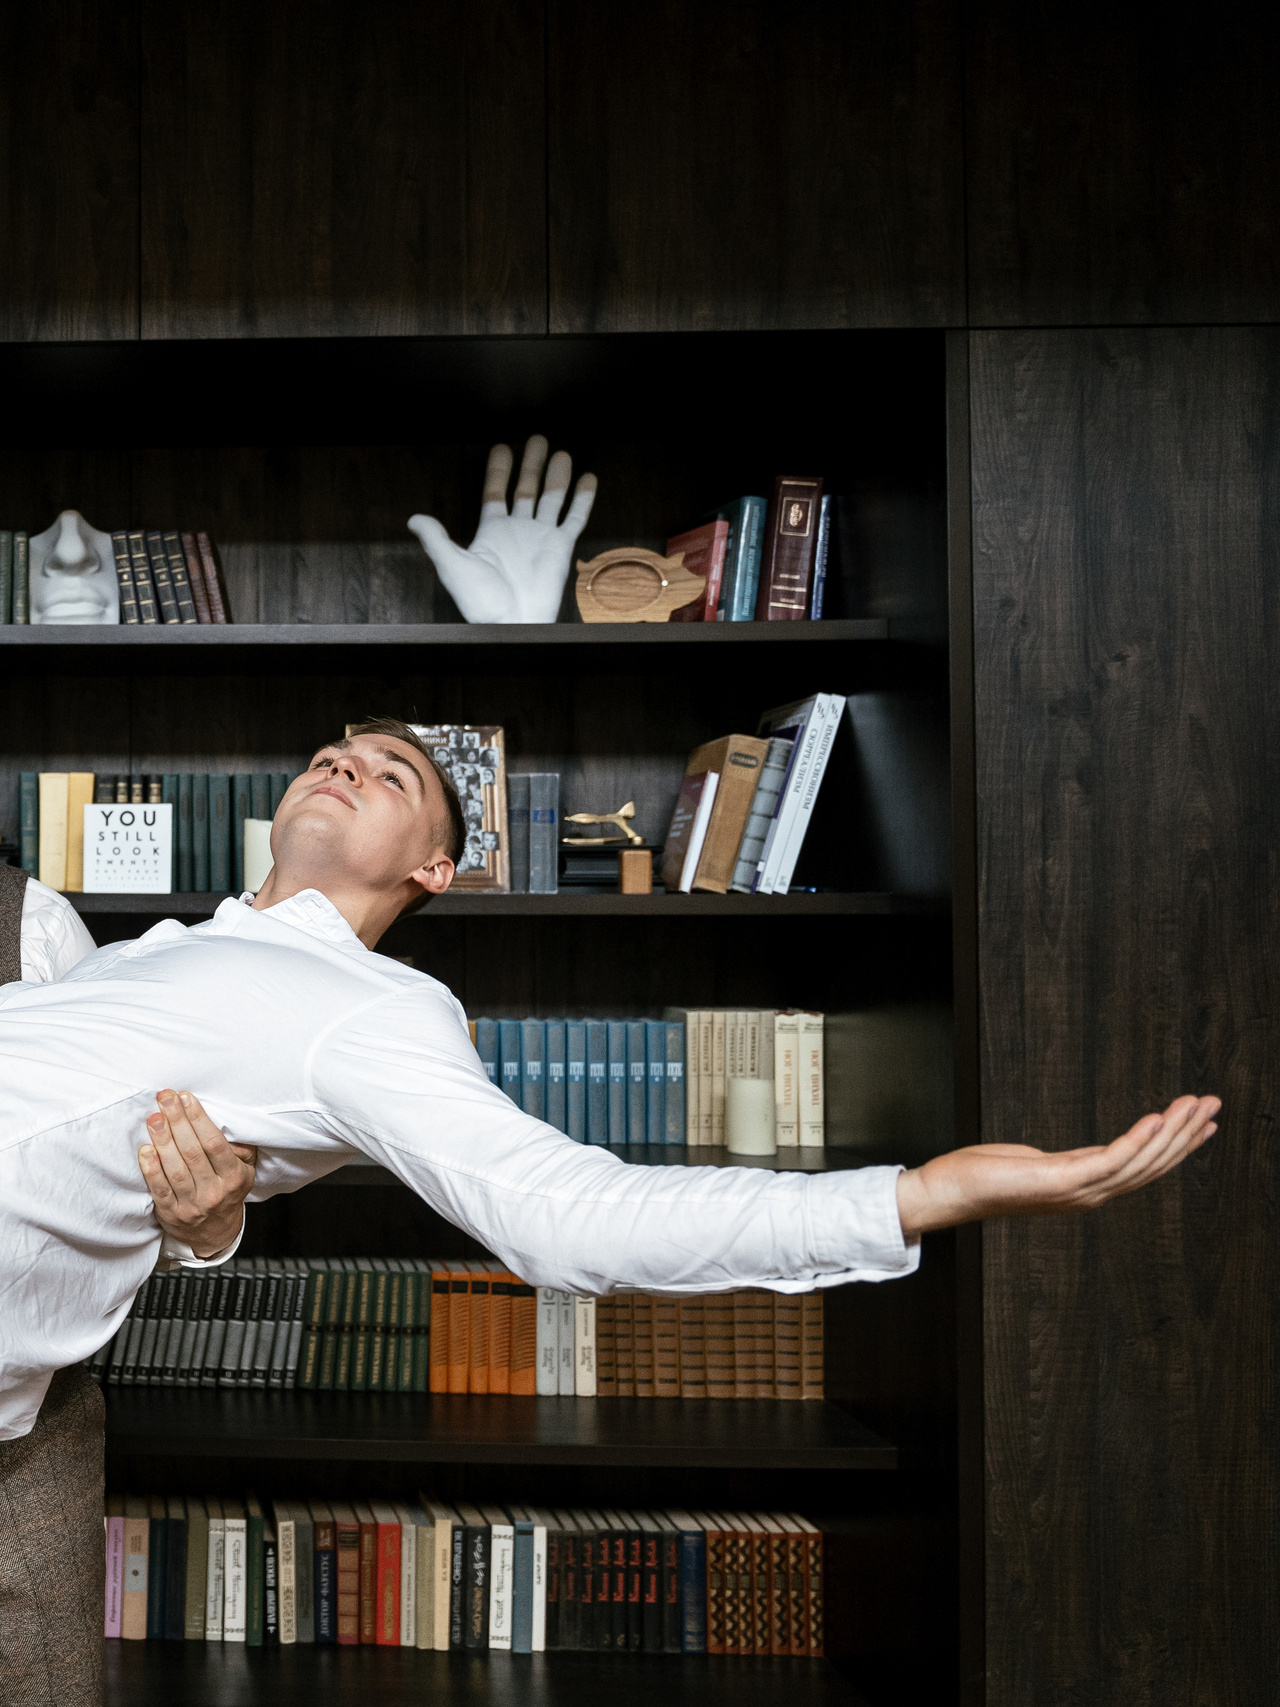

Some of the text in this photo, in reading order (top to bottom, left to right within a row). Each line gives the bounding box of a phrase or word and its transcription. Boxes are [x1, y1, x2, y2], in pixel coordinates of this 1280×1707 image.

[793, 728, 818, 793] СЮРРЕАЛИЗМ
[802, 725, 834, 810] ИМПРЕССИОНИЗМ
[98, 831, 155, 841] STILL
[101, 810, 156, 826] YOU
[96, 847, 160, 856] LOOK
[320, 1554, 329, 1596] ФАУСТУС
[320, 1598, 330, 1636] ДОКТОР
